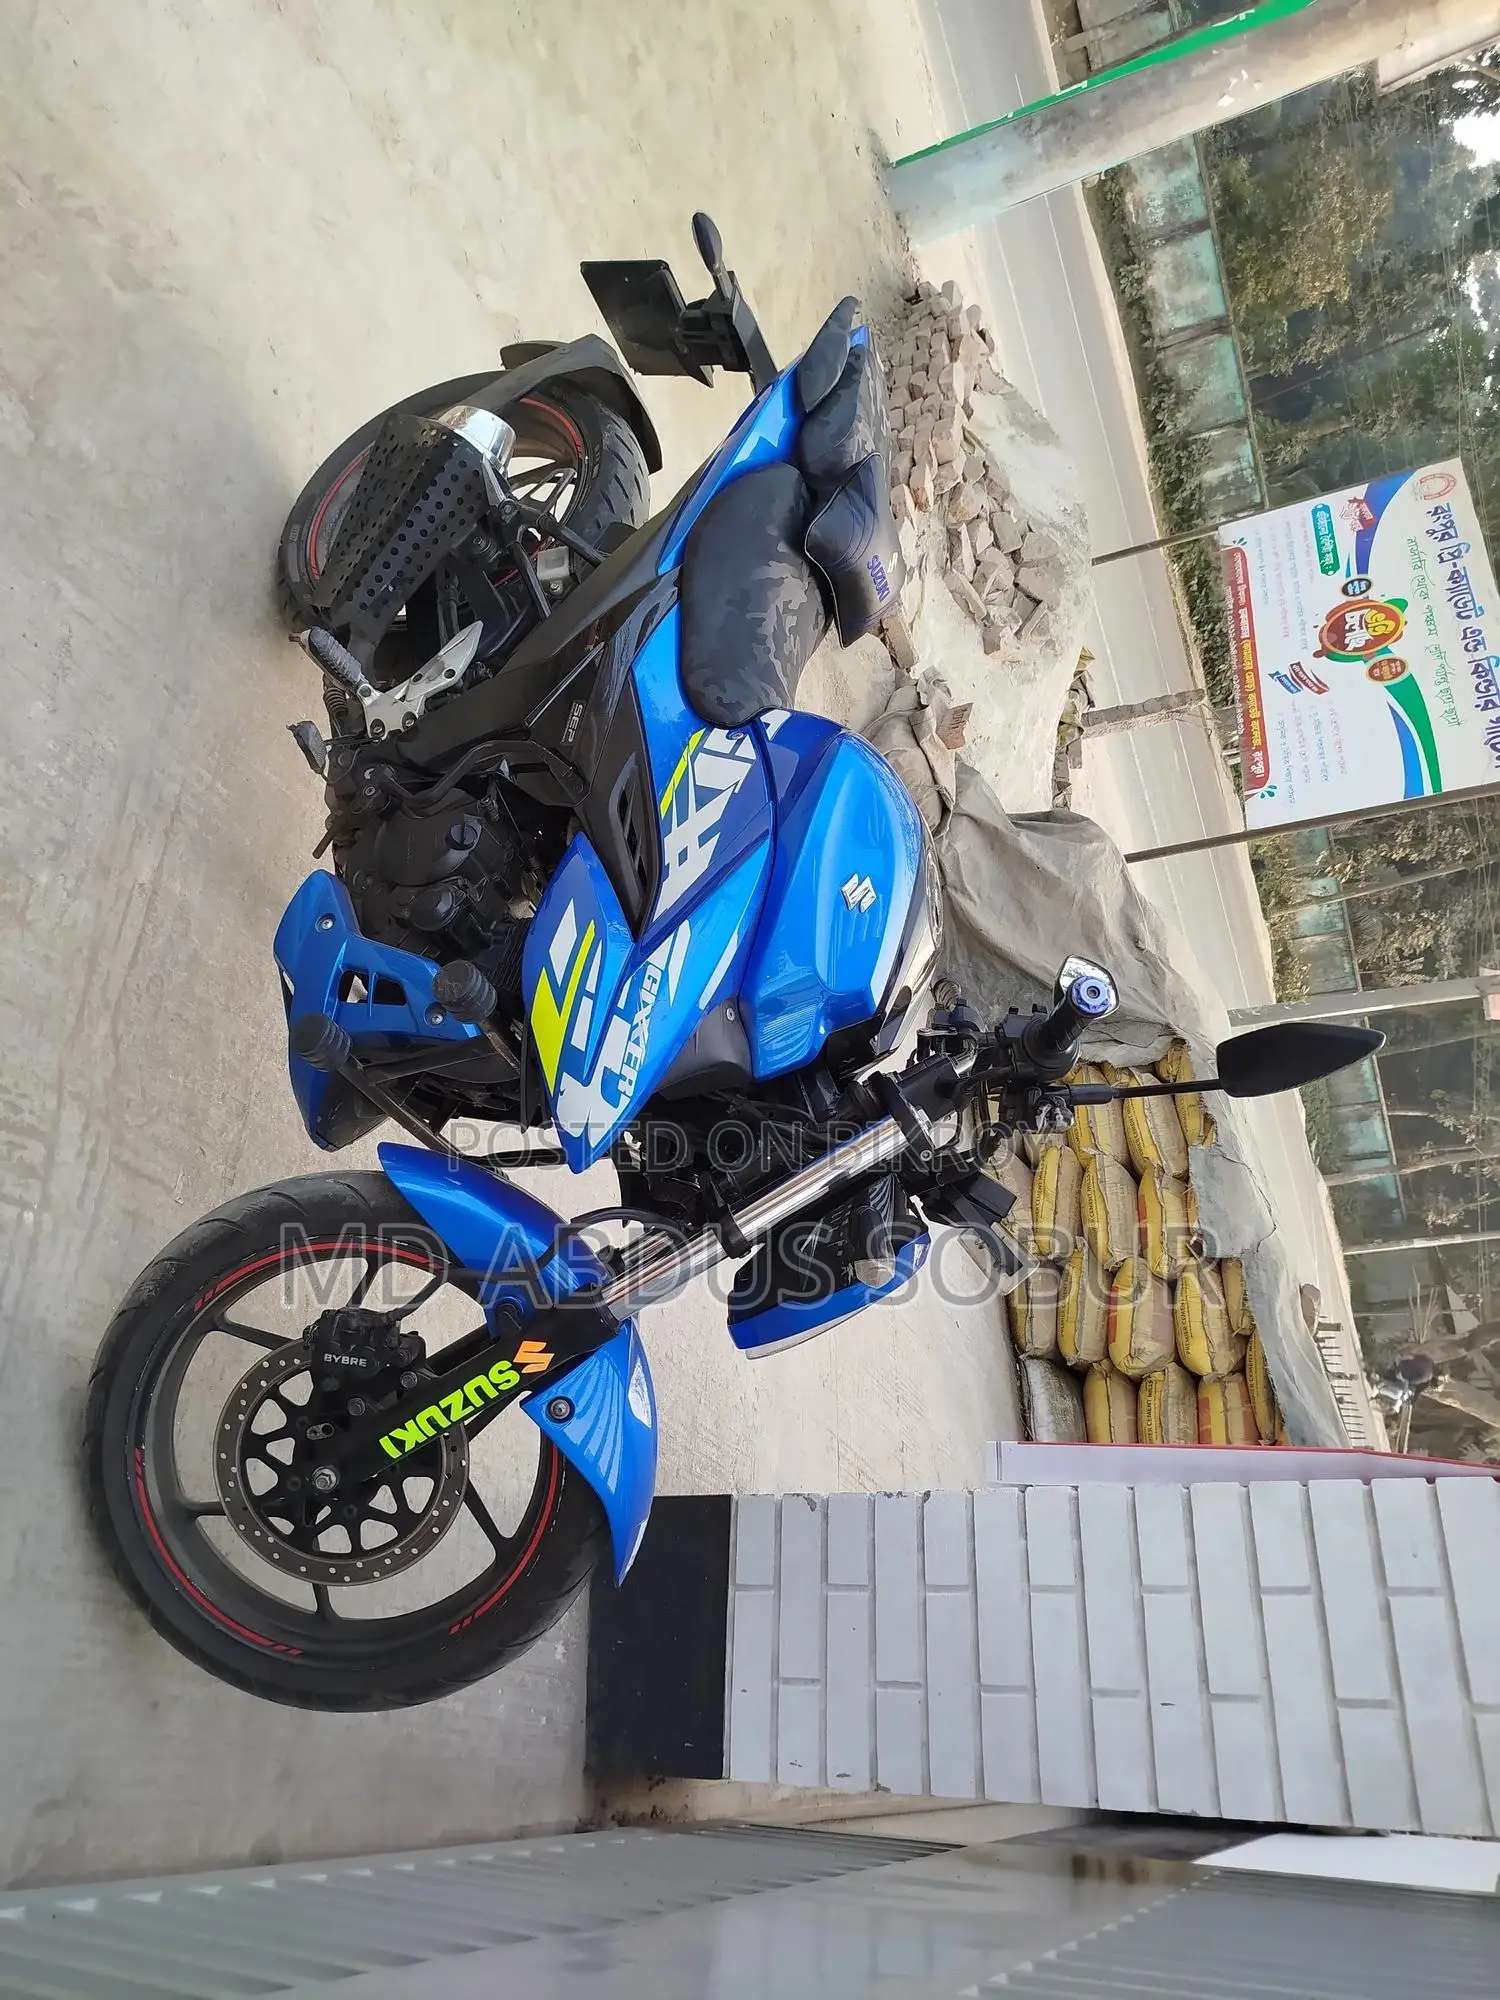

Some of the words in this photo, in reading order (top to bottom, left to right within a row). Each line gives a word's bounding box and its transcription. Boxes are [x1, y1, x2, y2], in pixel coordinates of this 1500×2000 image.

[867, 554, 890, 603] SUZUKI
[1426, 503, 1459, 543] রংপুর
[1461, 627, 1487, 653] এন্ড
[568, 703, 584, 743] SEP
[620, 963, 663, 1098] GIXXER
[324, 1353, 367, 1368] BYBRE
[1182, 1325, 1191, 1356] PREMIER
[378, 1359, 521, 1460] SUZUKI
